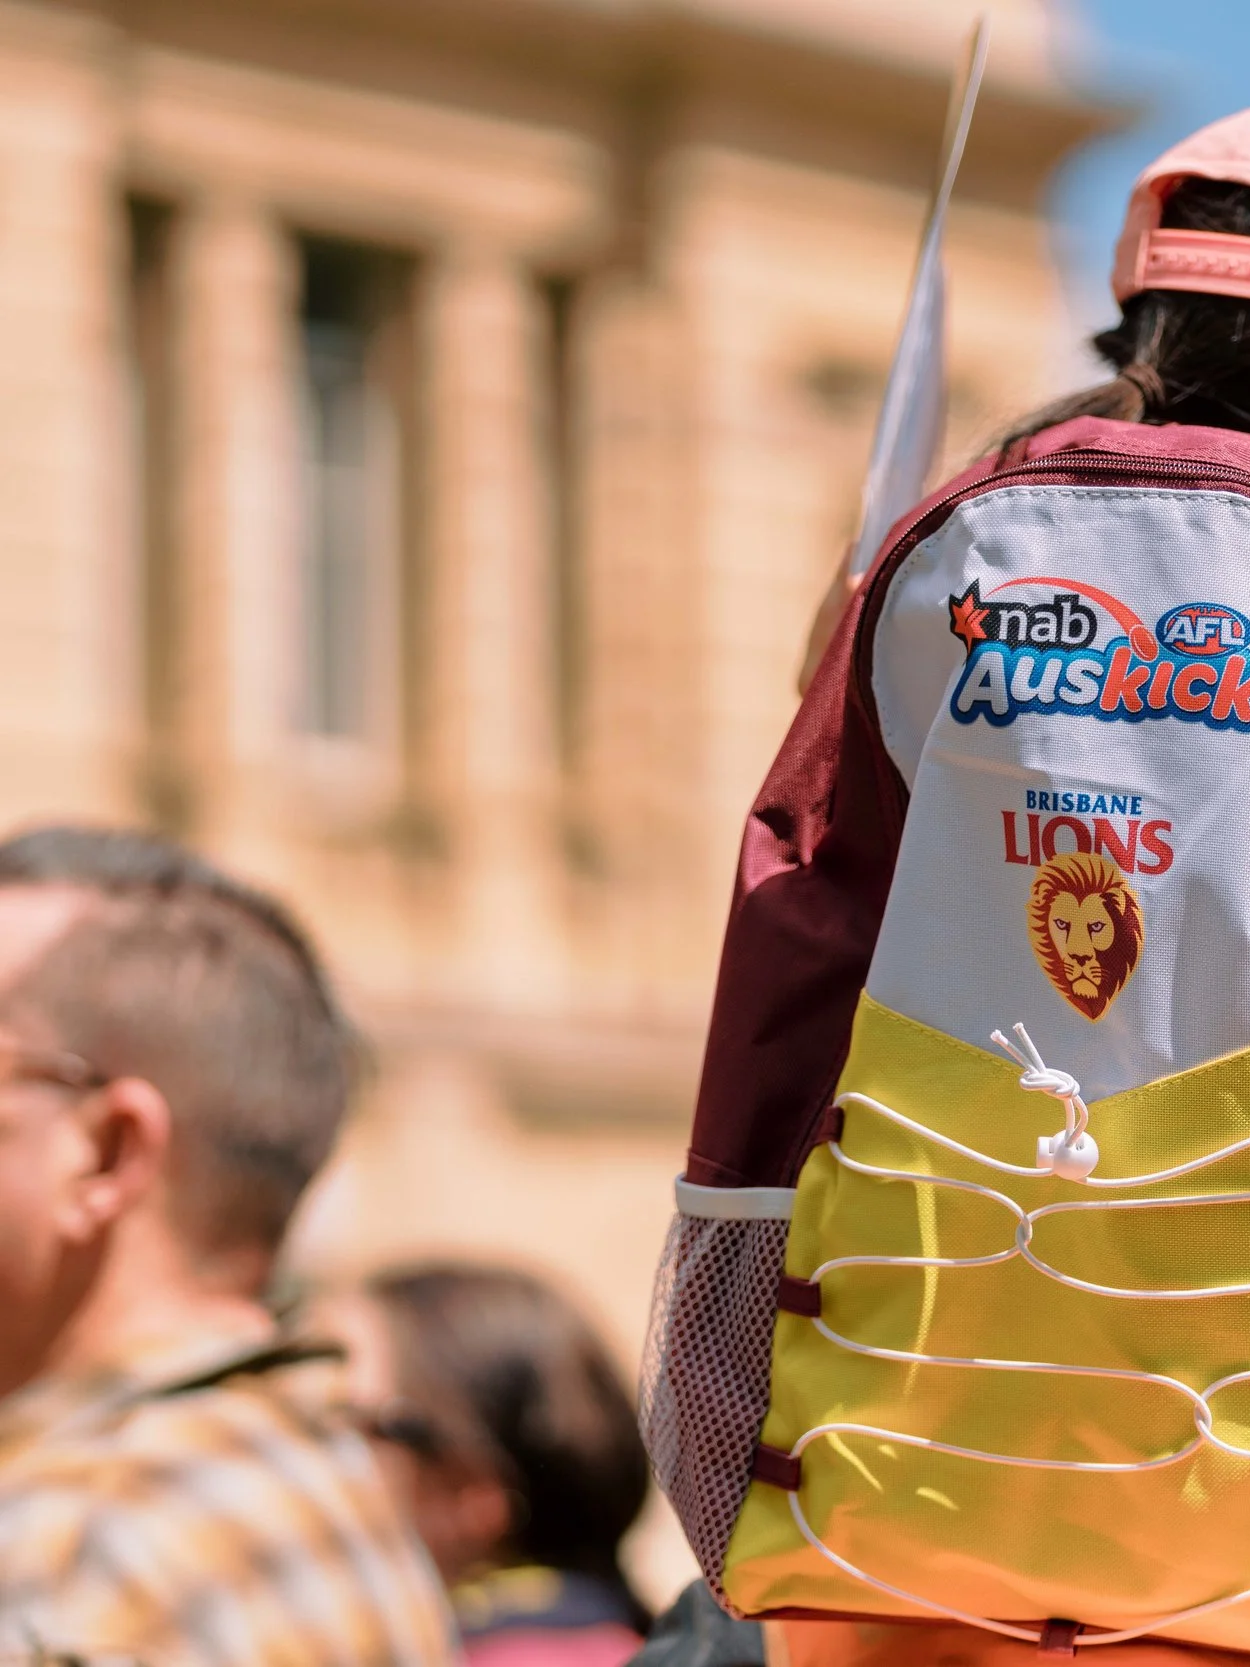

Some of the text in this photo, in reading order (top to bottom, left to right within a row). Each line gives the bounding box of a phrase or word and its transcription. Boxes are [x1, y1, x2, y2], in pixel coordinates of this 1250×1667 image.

[999, 601, 1091, 645] nab
[1164, 615, 1245, 647] AFL
[1026, 790, 1143, 815] BRISBANE
[1001, 810, 1174, 876] LIONS
